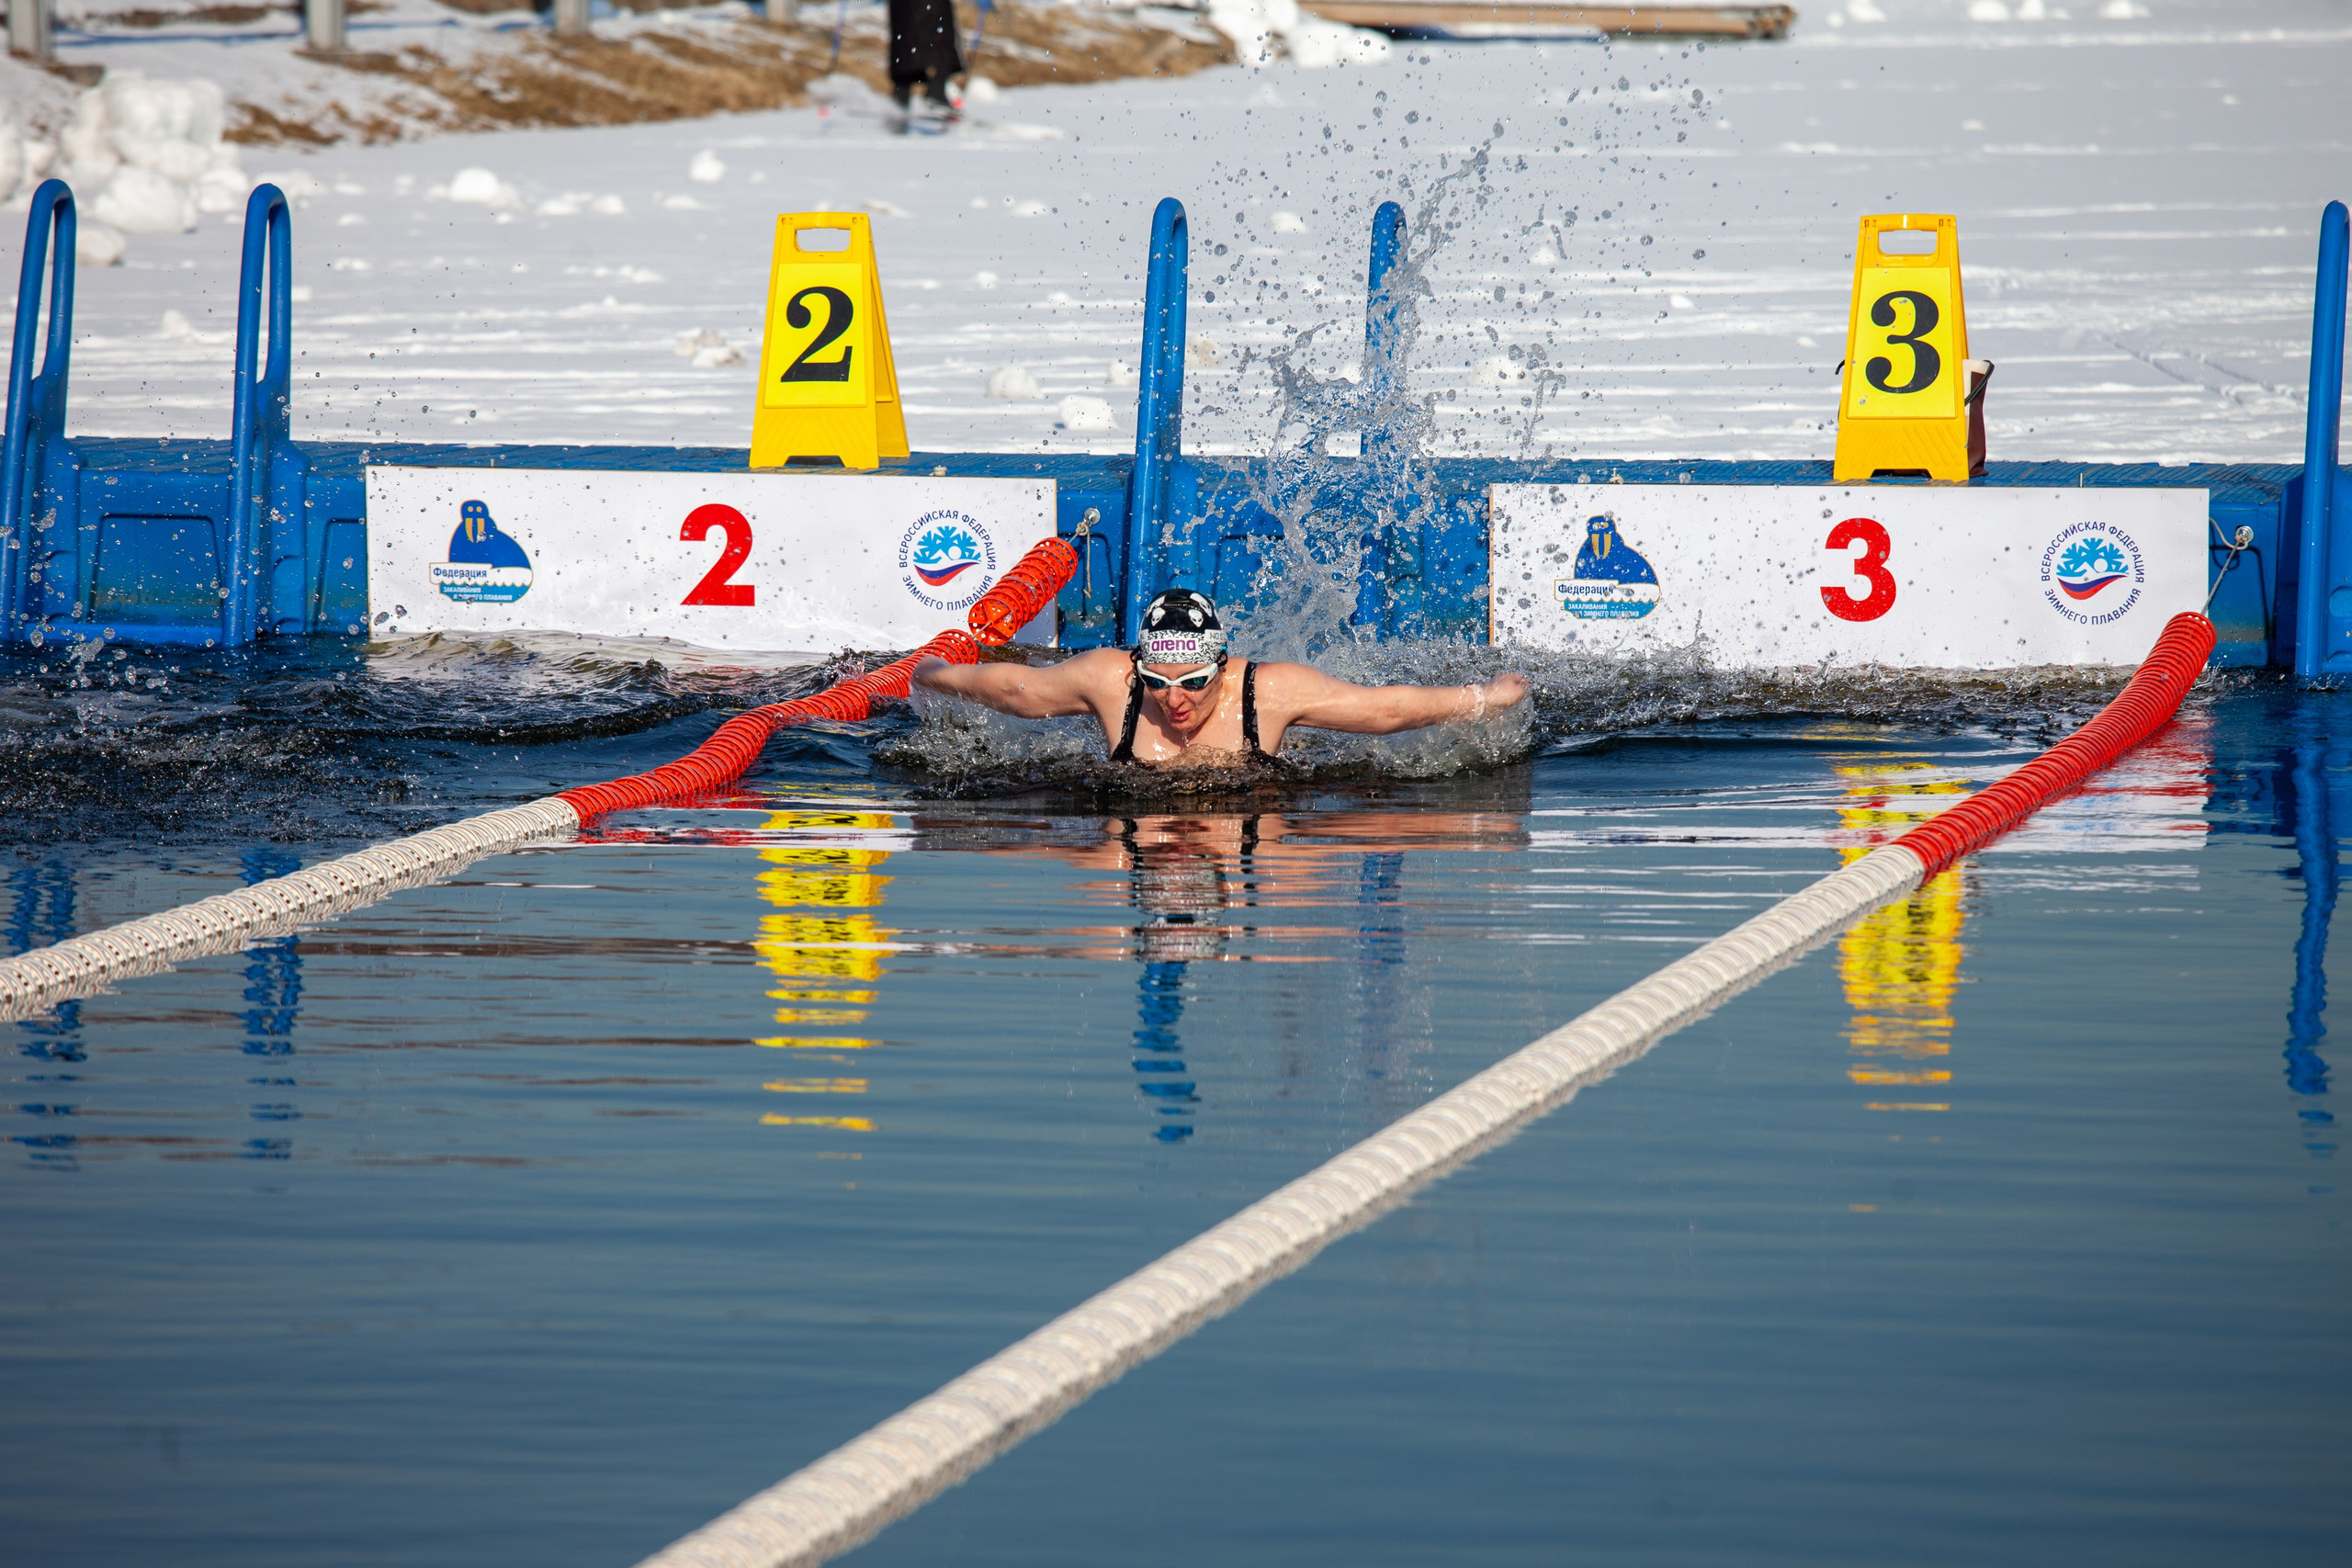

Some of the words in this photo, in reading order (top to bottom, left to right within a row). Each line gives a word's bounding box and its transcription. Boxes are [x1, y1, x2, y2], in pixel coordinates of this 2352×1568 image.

[781, 287, 854, 383] 2
[1866, 291, 1940, 394] 3
[680, 504, 755, 607] 2
[899, 510, 959, 568] ВСЕРОССИЙСКАЯ
[961, 514, 996, 570] ФЕДЕРАЦИЯ
[1821, 518, 1897, 622] 3
[2041, 521, 2106, 581] ВСЕРОССИЙСКАЯ
[2109, 526, 2145, 583] ФЕДЕРАЦИЯ
[433, 568, 488, 580] Федерация
[902, 575, 944, 611] ЗИМНЕГО
[946, 575, 993, 611] ПЛАВАНИЯ
[1557, 583, 1614, 596] Федерация
[2045, 589, 2087, 625] ЗИМНЕГО
[2091, 588, 2142, 625] ПЛАВАНИЯ
[1151, 639, 1196, 652] arena
